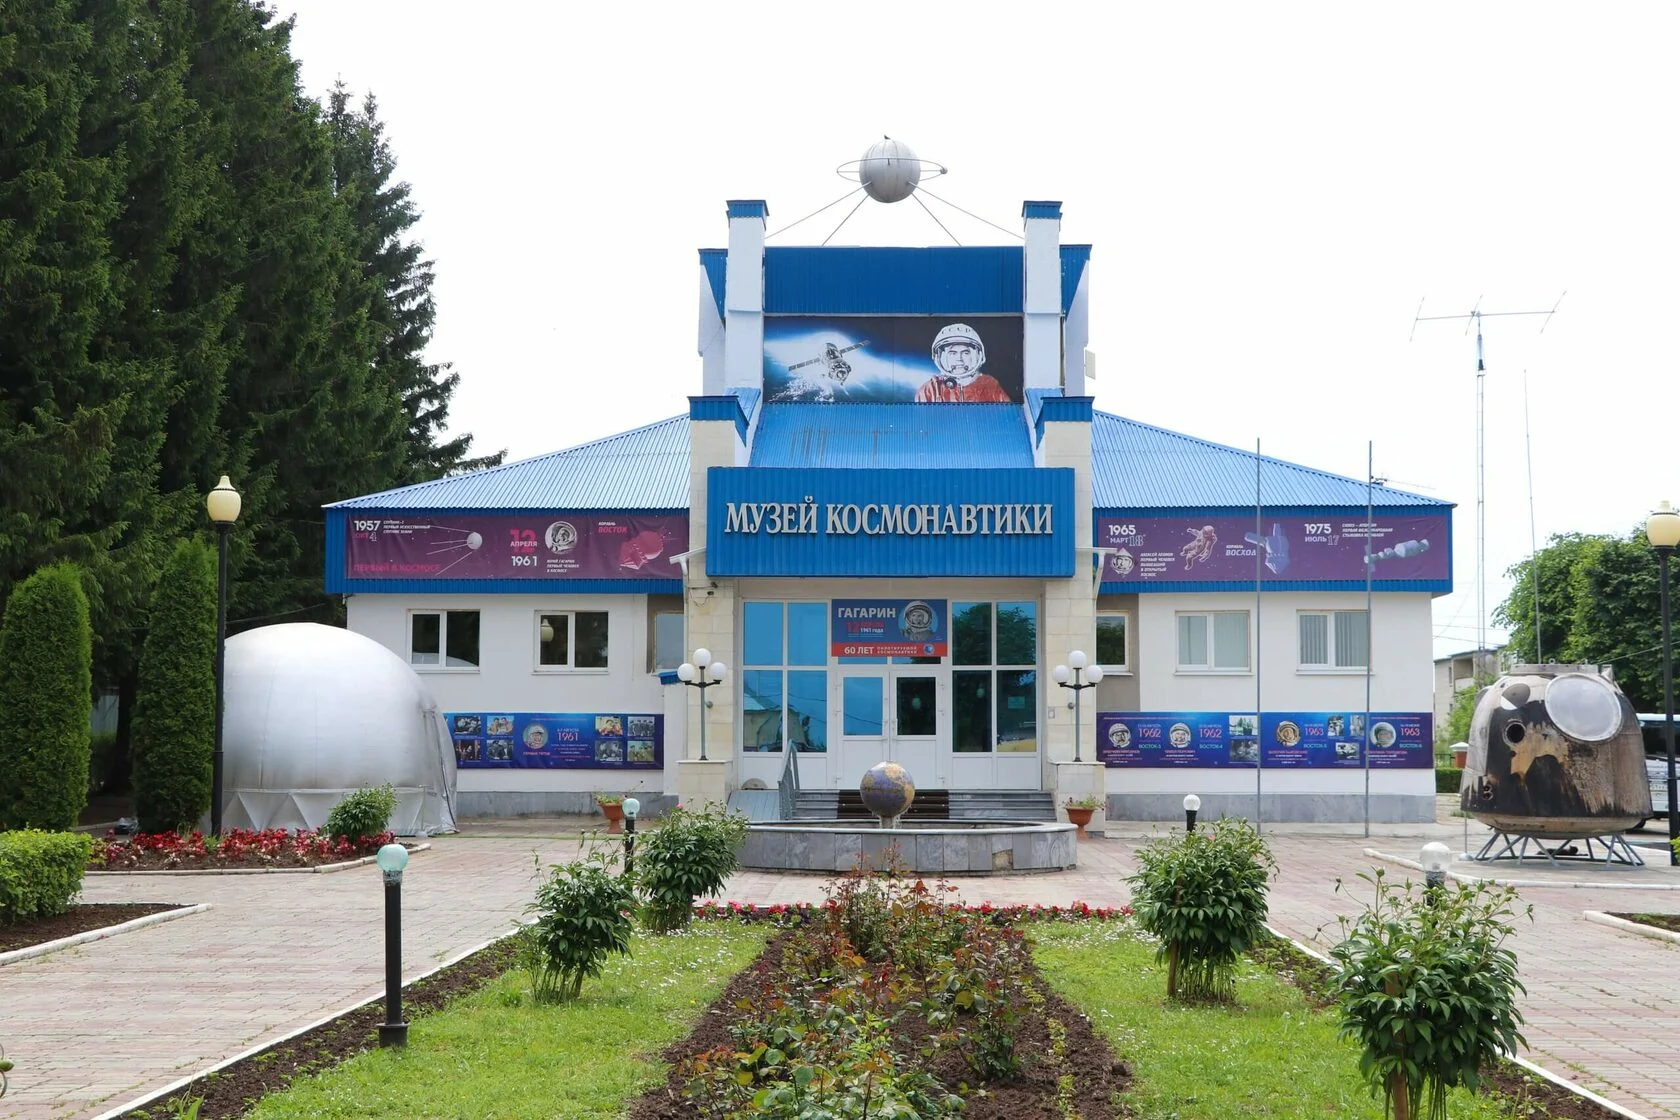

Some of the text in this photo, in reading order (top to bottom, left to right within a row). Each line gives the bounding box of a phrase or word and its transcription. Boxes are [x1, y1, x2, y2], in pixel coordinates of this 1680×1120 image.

[724, 495, 1053, 535] МУЗЕЙ КОСМОНАВТИКИ
[354, 520, 381, 531] 1957
[1108, 524, 1136, 535] 1965
[1304, 523, 1332, 534] 1975
[510, 527, 536, 554] 12
[1129, 534, 1144, 546] 18
[1328, 535, 1339, 545] 17
[511, 555, 537, 567] 1961
[837, 607, 896, 618] ГАГАРИН
[557, 732, 579, 741] 1961
[1138, 728, 1161, 738] 1962
[1200, 728, 1222, 738] 1962
[1304, 727, 1324, 736] 1963
[1400, 727, 1420, 736] 1963
